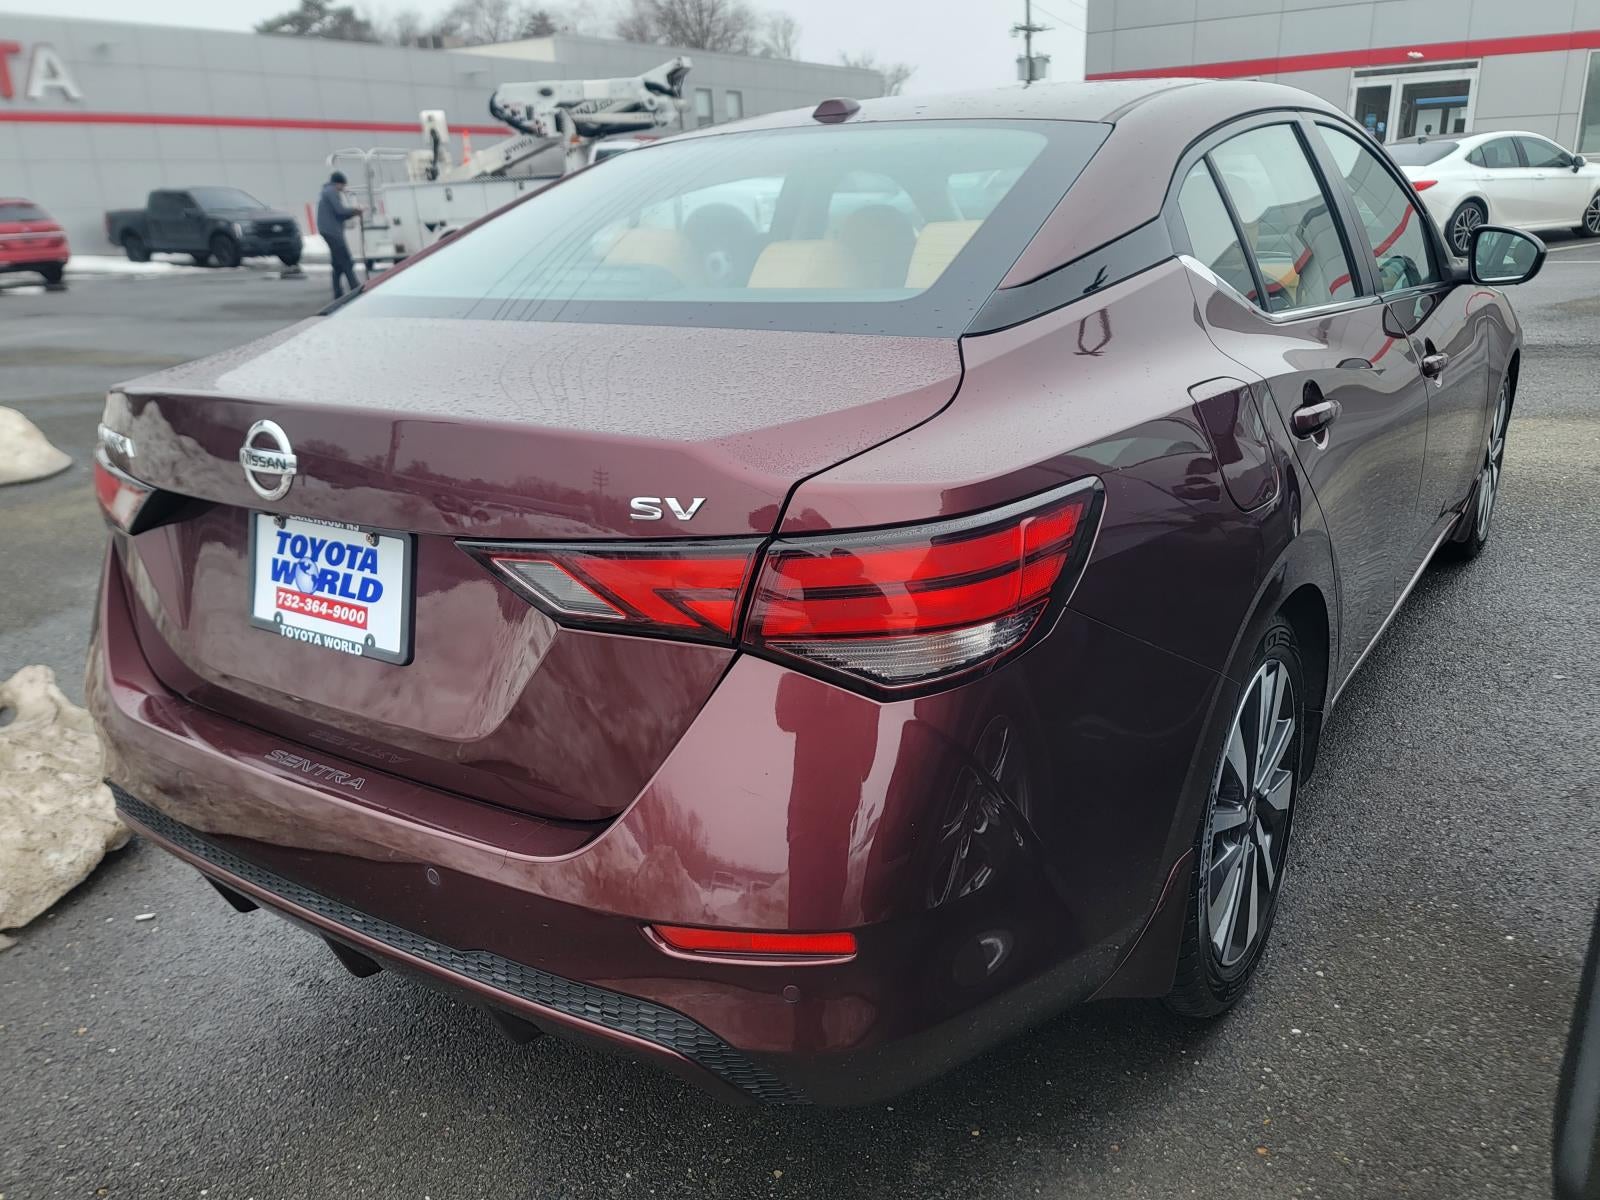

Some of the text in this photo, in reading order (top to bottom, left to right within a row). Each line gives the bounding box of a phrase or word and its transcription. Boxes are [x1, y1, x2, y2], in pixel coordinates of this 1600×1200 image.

[241, 450, 287, 470] NISSAN
[630, 497, 706, 521] SV
[276, 530, 378, 575] TOYOTA
[271, 557, 384, 603] WORLD
[277, 591, 366, 625] 732-364-9000
[280, 624, 363, 656] TOYOTA WORLD
[264, 749, 366, 791] SENTRA
